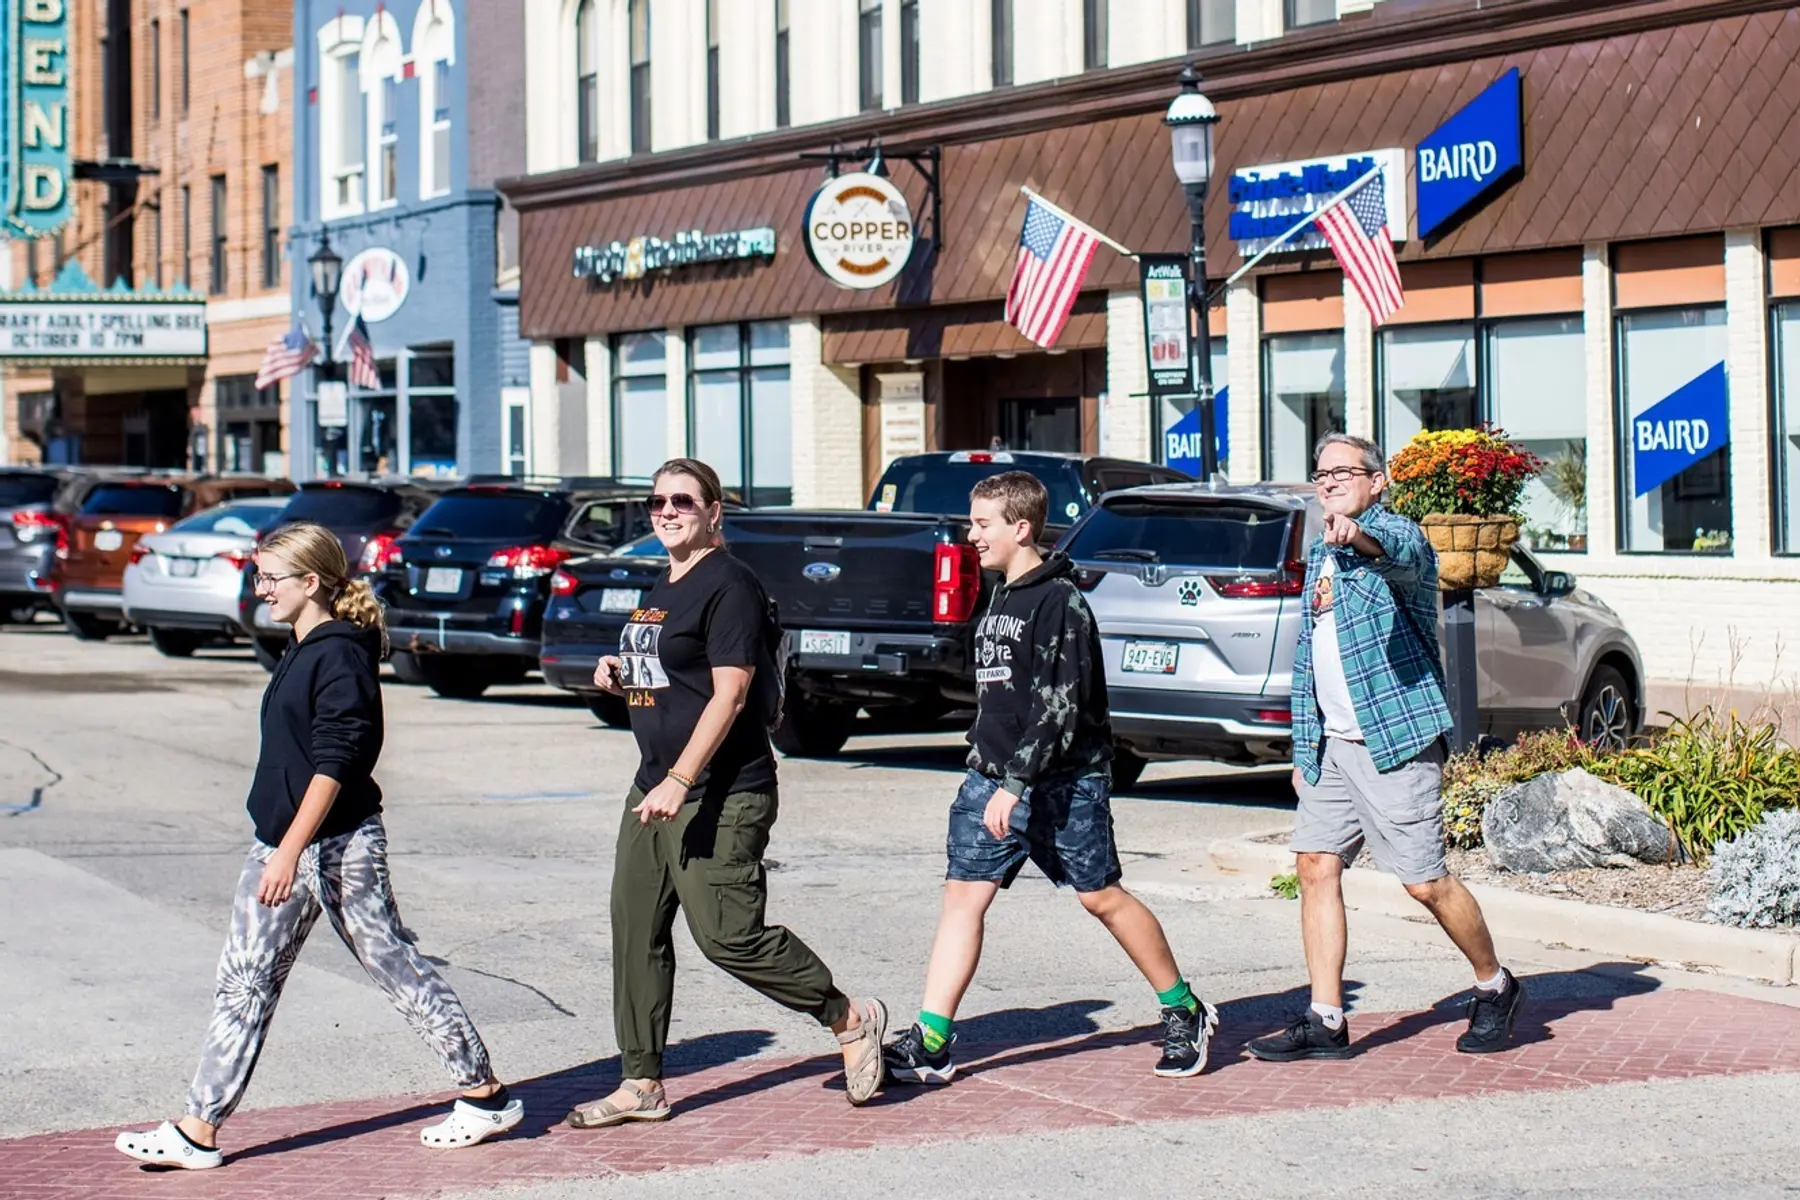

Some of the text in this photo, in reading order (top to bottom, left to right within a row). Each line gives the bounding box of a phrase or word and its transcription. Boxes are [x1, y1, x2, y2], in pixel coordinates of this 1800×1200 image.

[1419, 141, 1497, 182] BAIRD
[814, 222, 909, 241] COPPER
[843, 244, 883, 253] RIVER
[1148, 264, 1182, 278] ArtWalk
[48, 314, 95, 329] ADULT
[101, 314, 171, 328] SPELLING
[176, 314, 201, 328] BEE
[12, 333, 79, 347] OCTOBER
[114, 333, 144, 347] 7PM
[1636, 419, 1709, 454] BAIRD
[1168, 433, 1220, 459] BAI
[1128, 649, 1172, 666] 947-EVG
[987, 670, 1006, 678] PARK
